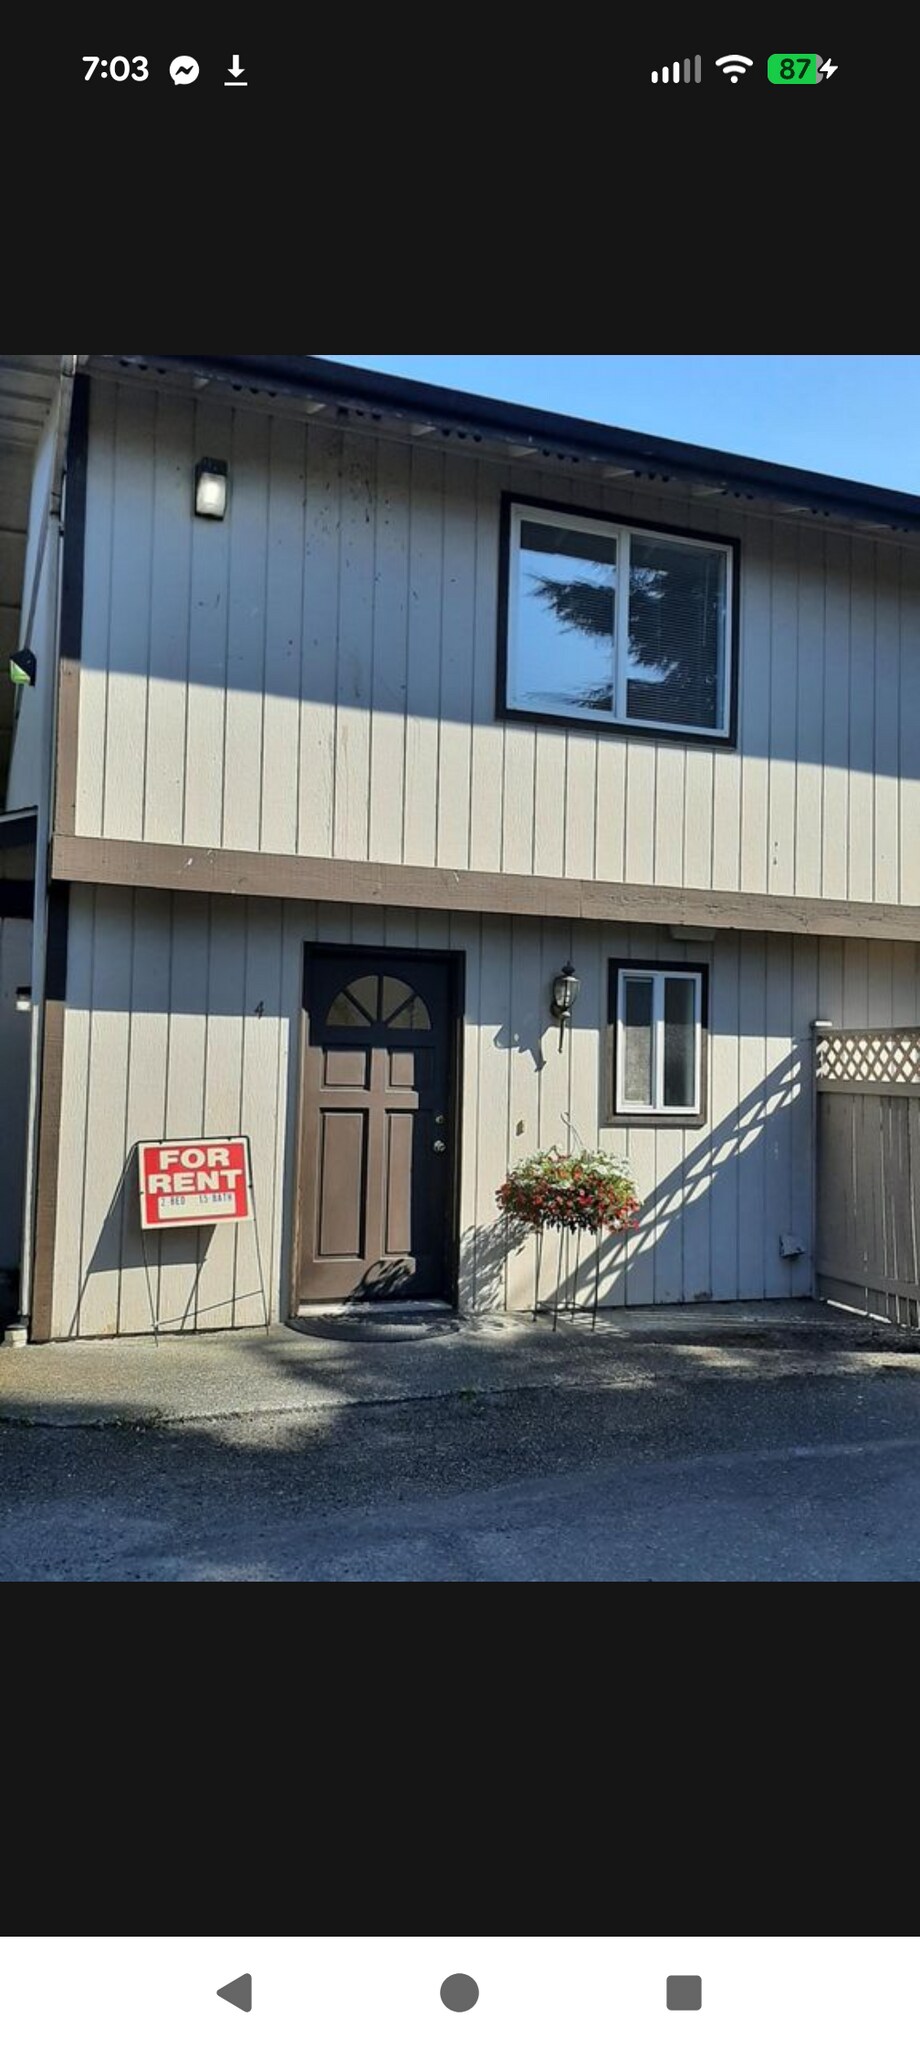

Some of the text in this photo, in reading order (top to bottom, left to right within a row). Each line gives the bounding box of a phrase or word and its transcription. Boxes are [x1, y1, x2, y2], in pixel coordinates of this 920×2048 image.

[254, 1001, 264, 1019] 4
[159, 1147, 230, 1170] FOR
[147, 1169, 243, 1194] RENT
